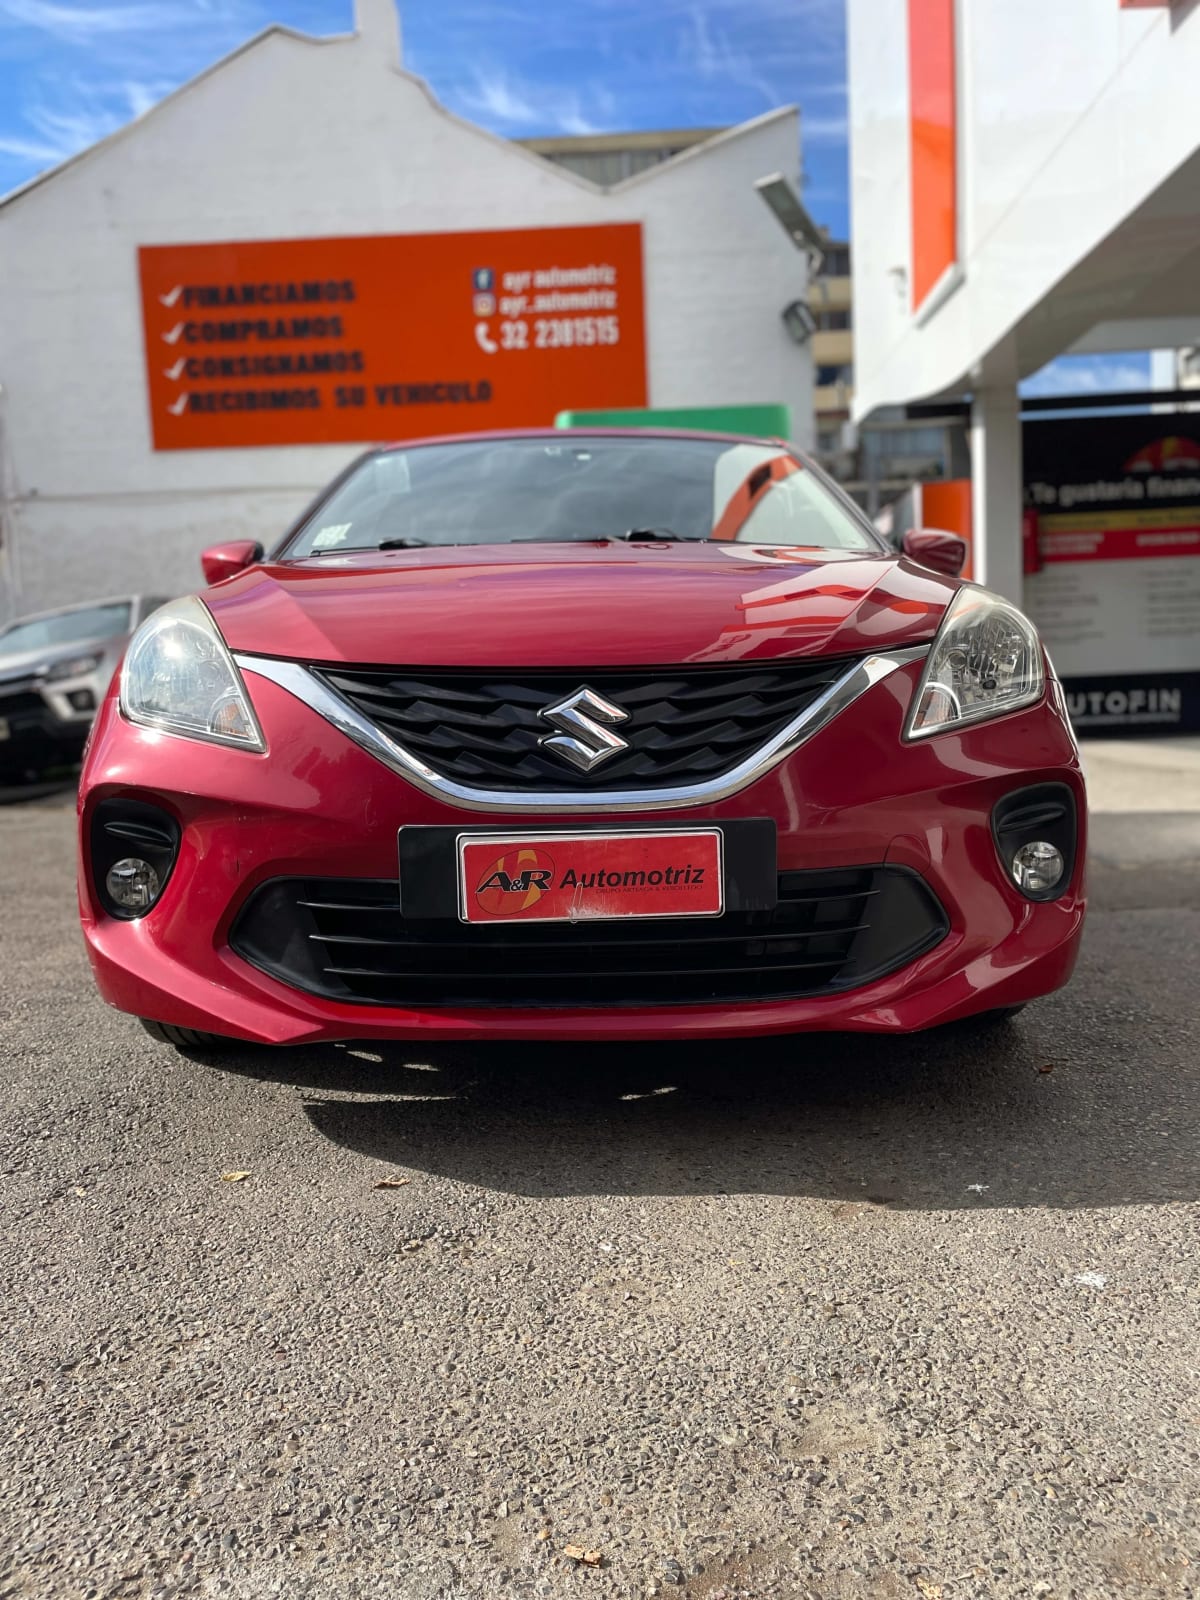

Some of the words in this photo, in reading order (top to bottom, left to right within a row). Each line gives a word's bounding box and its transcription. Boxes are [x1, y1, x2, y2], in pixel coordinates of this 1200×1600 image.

[182, 279, 356, 309] FINANCIAMOS
[502, 270, 532, 295] ayr
[533, 263, 617, 289] automotriz
[183, 314, 344, 344] COMPRAMOS
[500, 318, 530, 350] 32
[184, 350, 365, 378] CONSIGNAMOS
[188, 387, 321, 413] RECIBIMOS
[335, 386, 366, 408] SU
[374, 380, 493, 406] VEHICULO
[1066, 688, 1181, 716] UTOFIN
[475, 868, 553, 894] A&R
[559, 864, 706, 890] Automotriz
